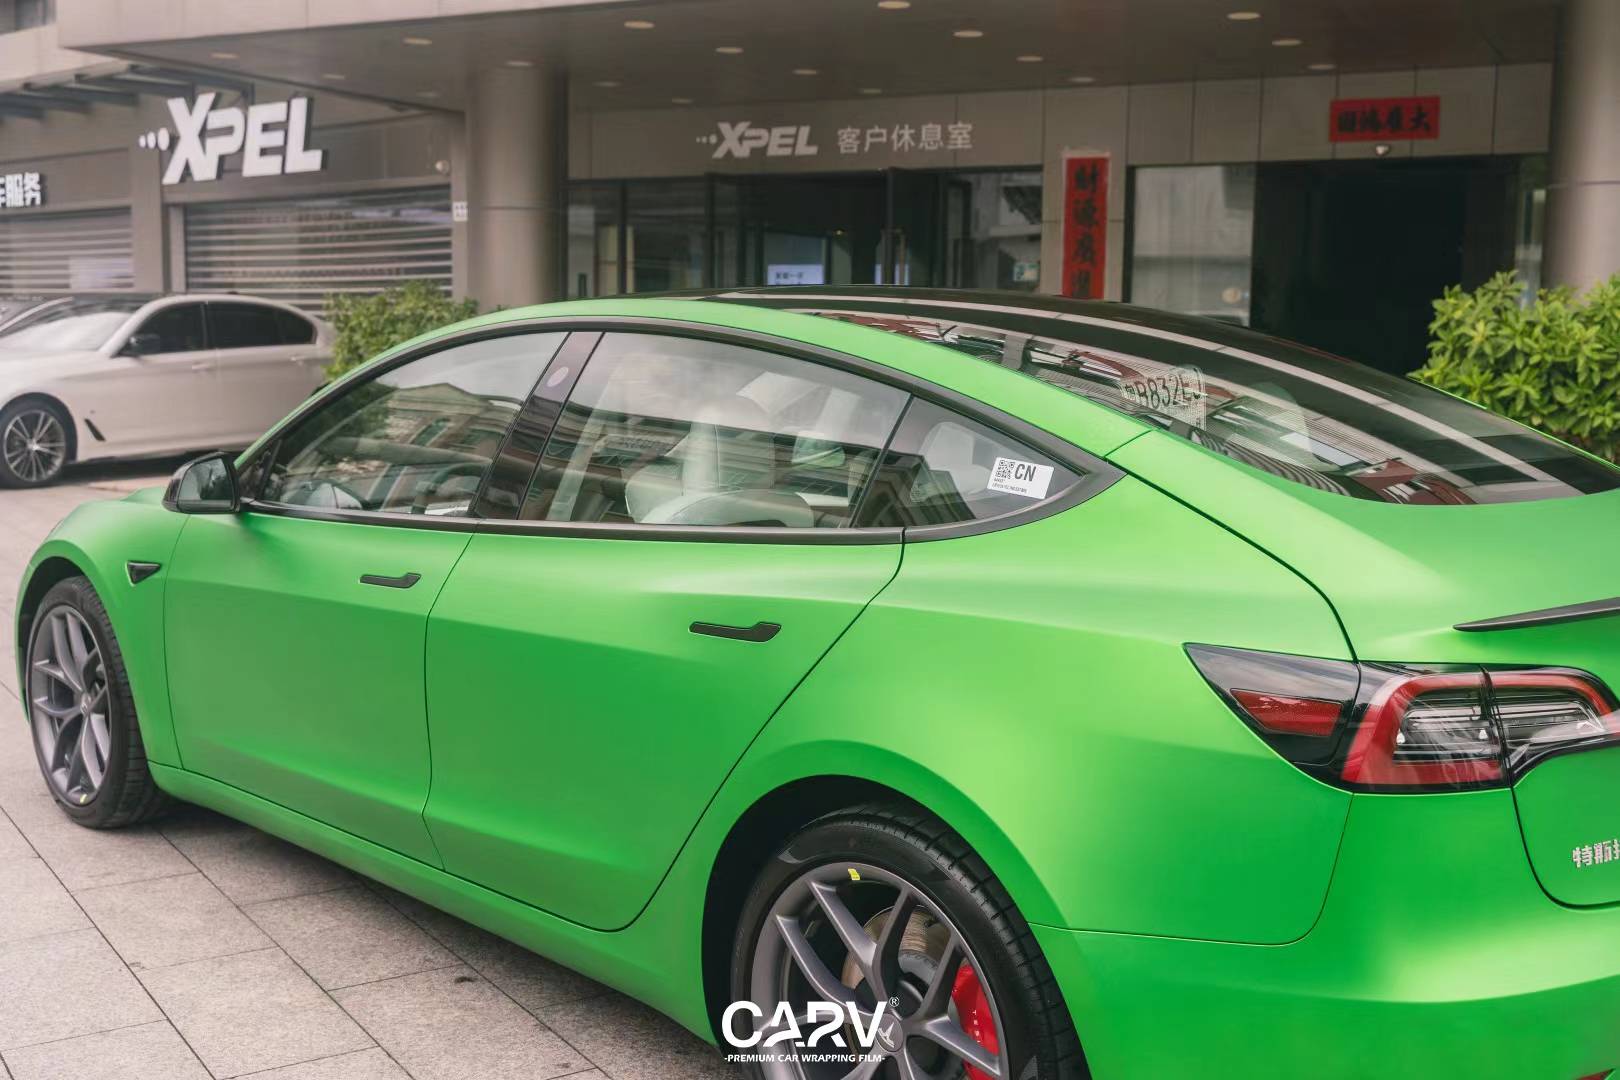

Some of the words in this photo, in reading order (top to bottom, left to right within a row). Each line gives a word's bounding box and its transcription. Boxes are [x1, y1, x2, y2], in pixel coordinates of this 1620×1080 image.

[162, 92, 323, 185] XPEL
[712, 121, 819, 159] XPEL
[837, 121, 973, 154] 客户休息室
[1014, 464, 1037, 482] CN
